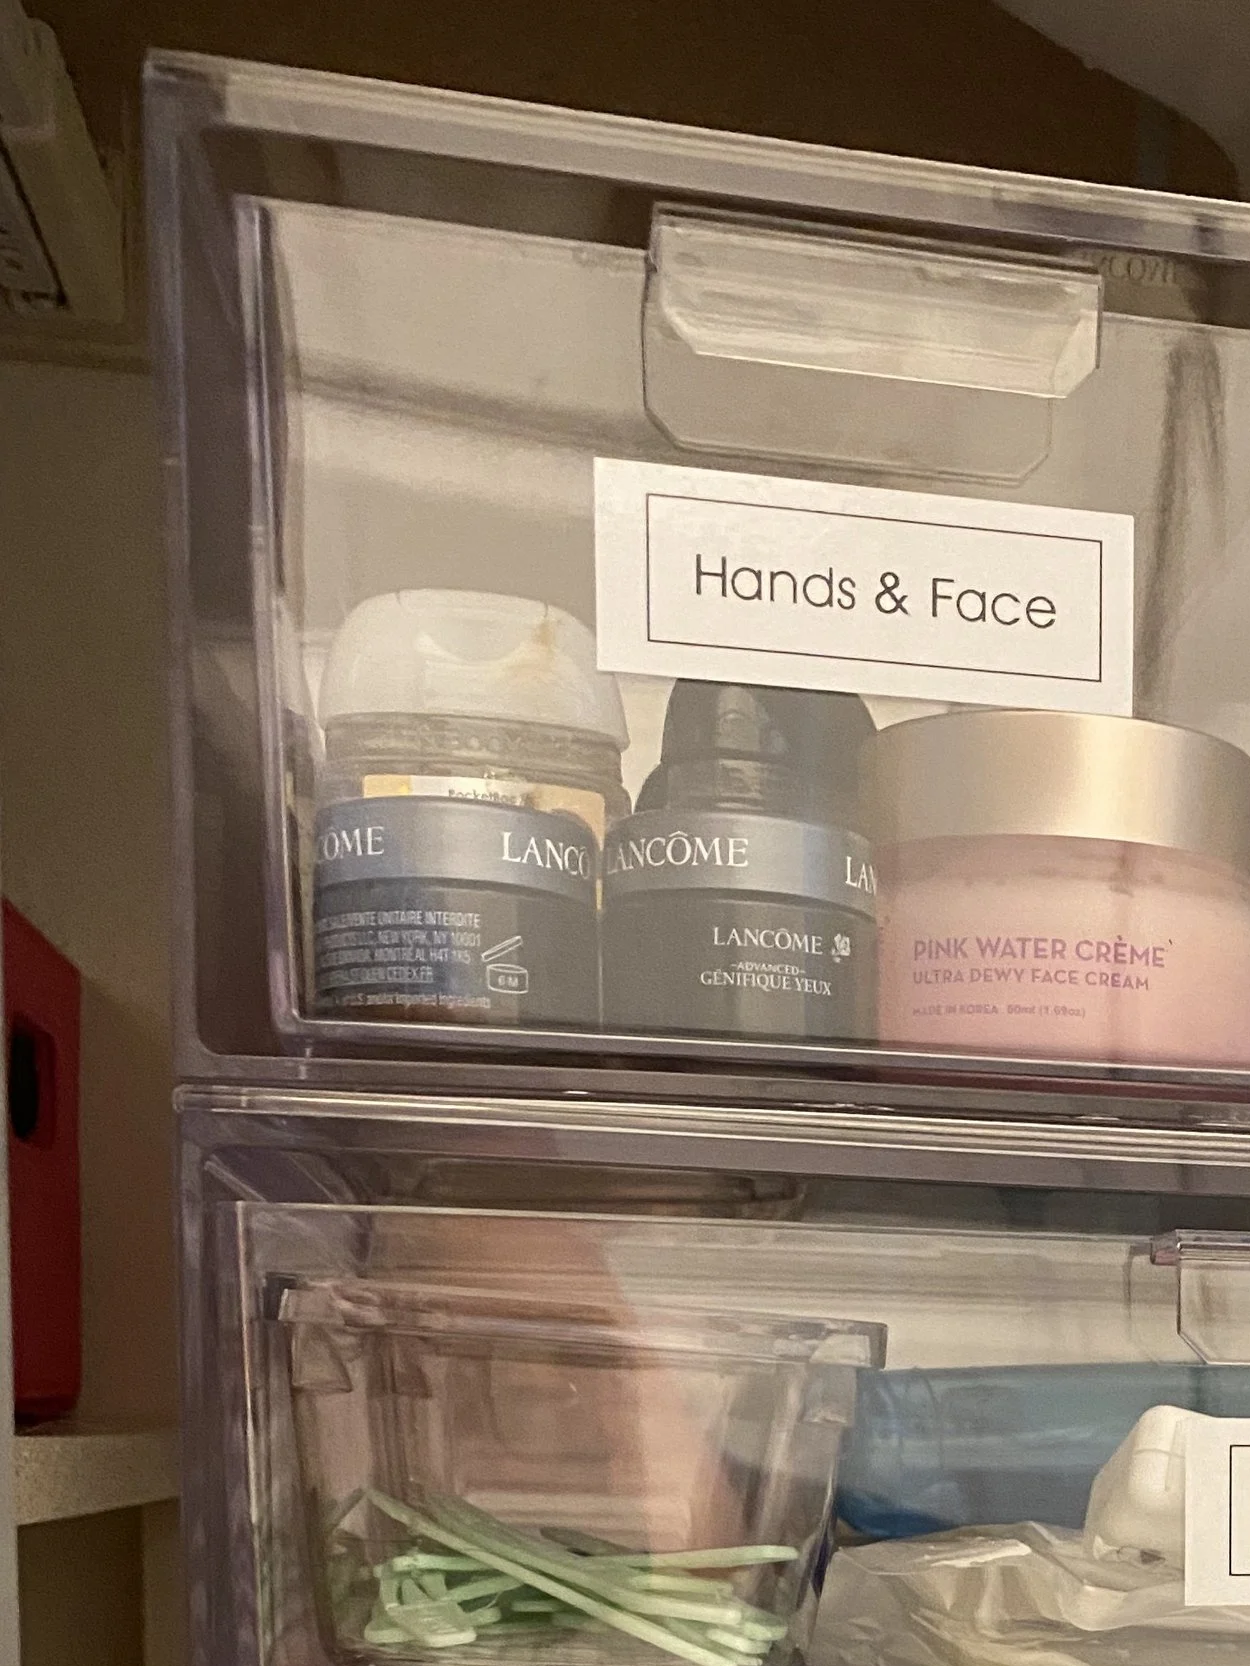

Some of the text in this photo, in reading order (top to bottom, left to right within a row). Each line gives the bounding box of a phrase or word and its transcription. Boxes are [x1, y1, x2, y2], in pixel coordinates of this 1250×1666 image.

[695, 553, 1058, 630] Hands & Face
[713, 926, 825, 957] LANCÔME
[913, 935, 1166, 968] PINK WATER CRÈME
[794, 974, 833, 996] YEUX
[913, 968, 1151, 992] ULTRA DEWY FACE CREAM
